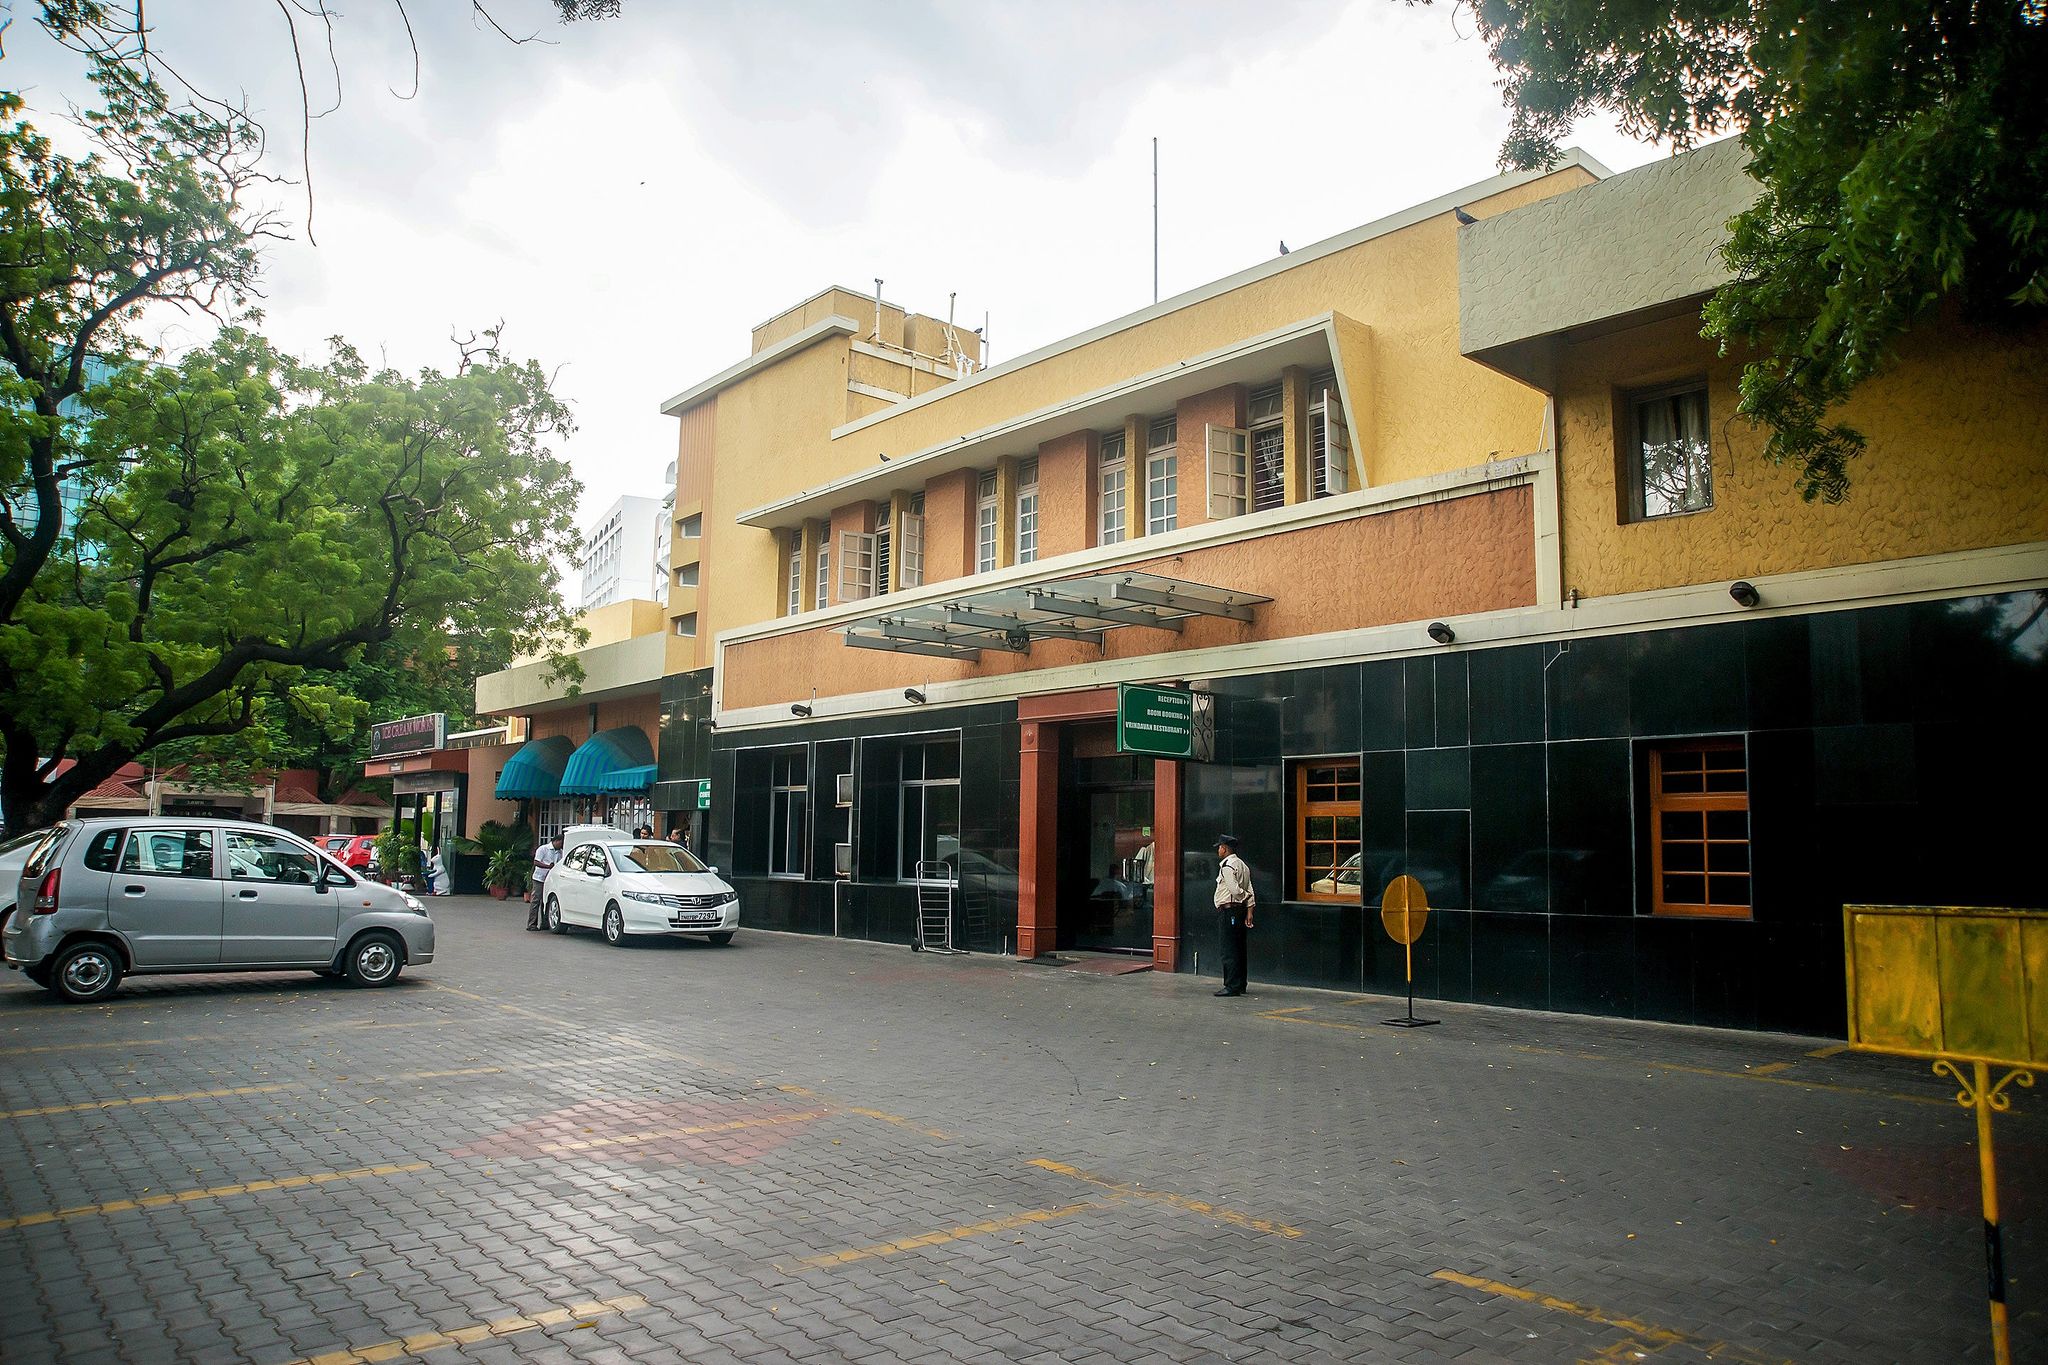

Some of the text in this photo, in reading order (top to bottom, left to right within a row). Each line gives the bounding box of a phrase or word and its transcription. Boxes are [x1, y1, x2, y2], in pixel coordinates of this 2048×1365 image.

[1158, 695, 1183, 704] RECEPTION
[1147, 709, 1183, 720] ROOM BOOKING
[1125, 721, 1183, 734] VRINDAVAN RESTAURANT
